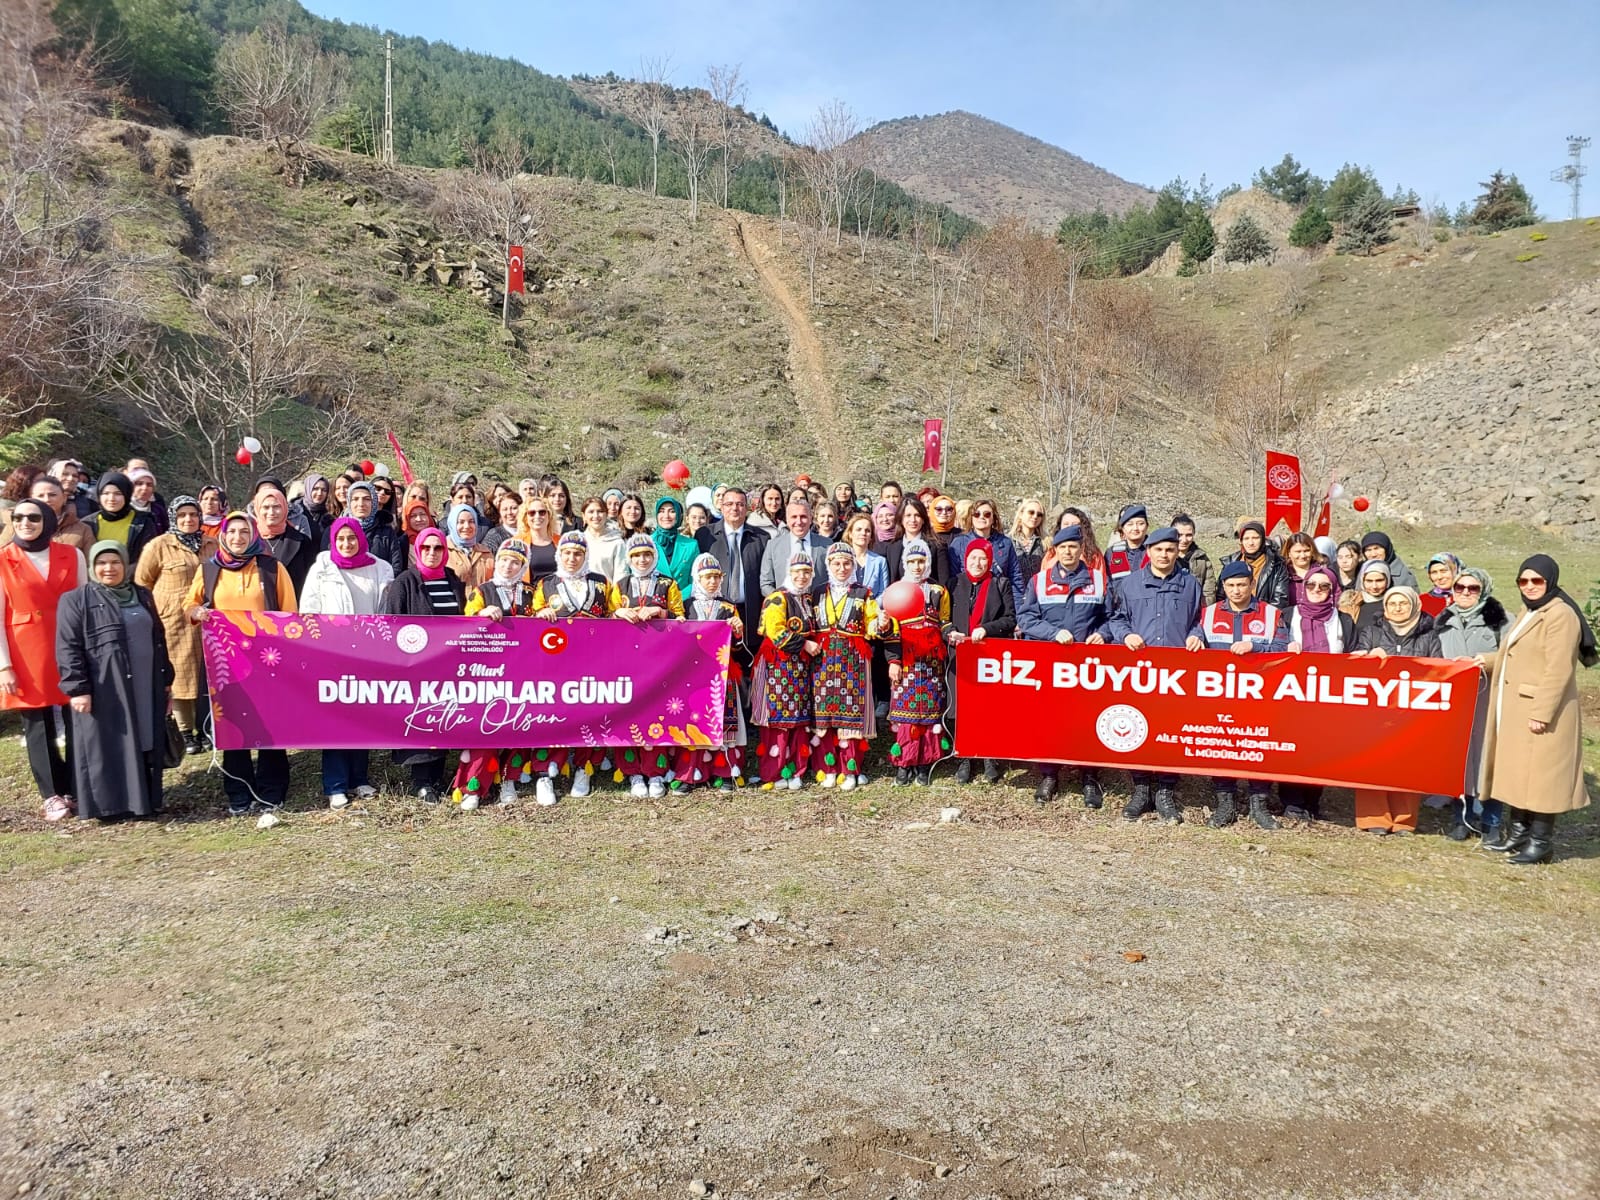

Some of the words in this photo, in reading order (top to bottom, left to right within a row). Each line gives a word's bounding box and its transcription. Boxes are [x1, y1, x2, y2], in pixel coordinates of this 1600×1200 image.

[457, 664, 466, 677] 8
[469, 663, 506, 677] Mart
[318, 675, 414, 704] DÜNYA
[420, 680, 556, 704] KADINLAR
[561, 676, 633, 704] GÜNÜ
[977, 651, 1042, 691] BİZ,
[1053, 657, 1187, 696] BÜYÜK
[1196, 663, 1264, 700] BİR
[1273, 665, 1453, 711] AİLEYİZ!
[404, 697, 474, 737] Kutlu
[480, 696, 567, 735] Olsun
[1216, 713, 1235, 723] T.C.
[1181, 724, 1225, 734] AMASYA
[1226, 725, 1269, 737] VALİLİĞİ
[1155, 733, 1178, 743] AİLE
[1180, 736, 1194, 745] VE
[1195, 736, 1234, 747] SOSYAL
[1236, 739, 1296, 752] HİZMETLER
[1184, 746, 1194, 756] İL
[1195, 748, 1264, 762] MÜDÜRLÜĞÜ
